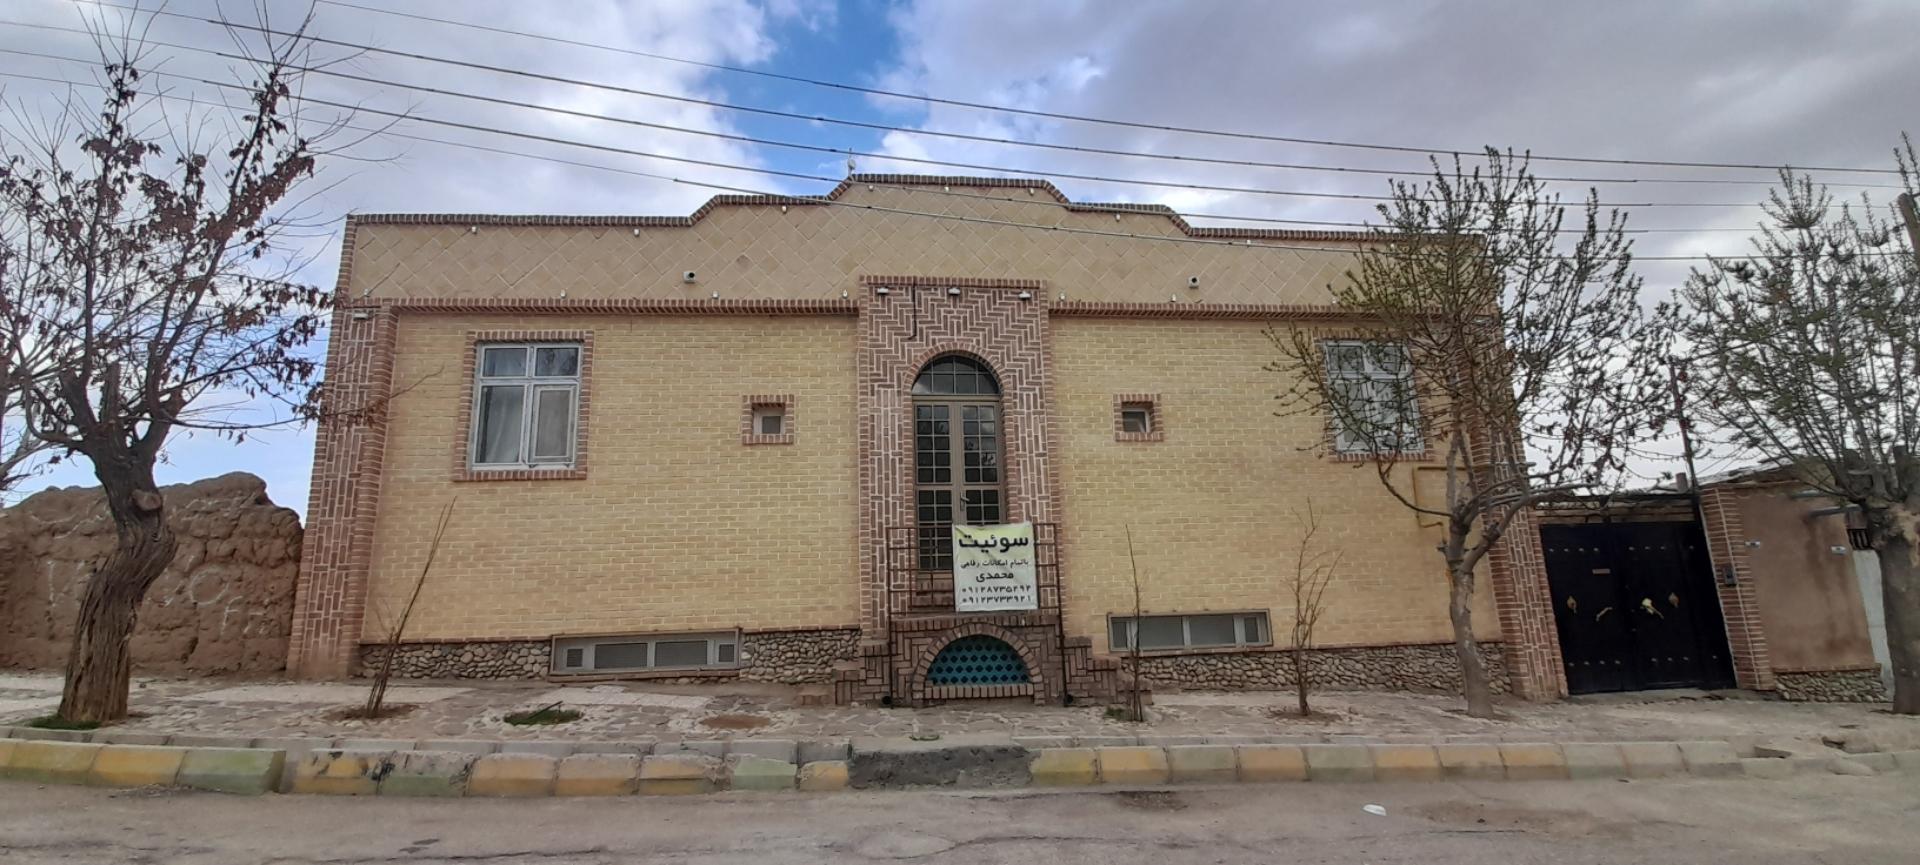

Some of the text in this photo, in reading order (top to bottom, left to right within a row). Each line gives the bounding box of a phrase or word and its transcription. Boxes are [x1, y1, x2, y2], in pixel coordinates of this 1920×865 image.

[959, 534, 1029, 553] سوئیت
[960, 559, 980, 569] رفاهی
[976, 572, 1014, 583] محمدی
